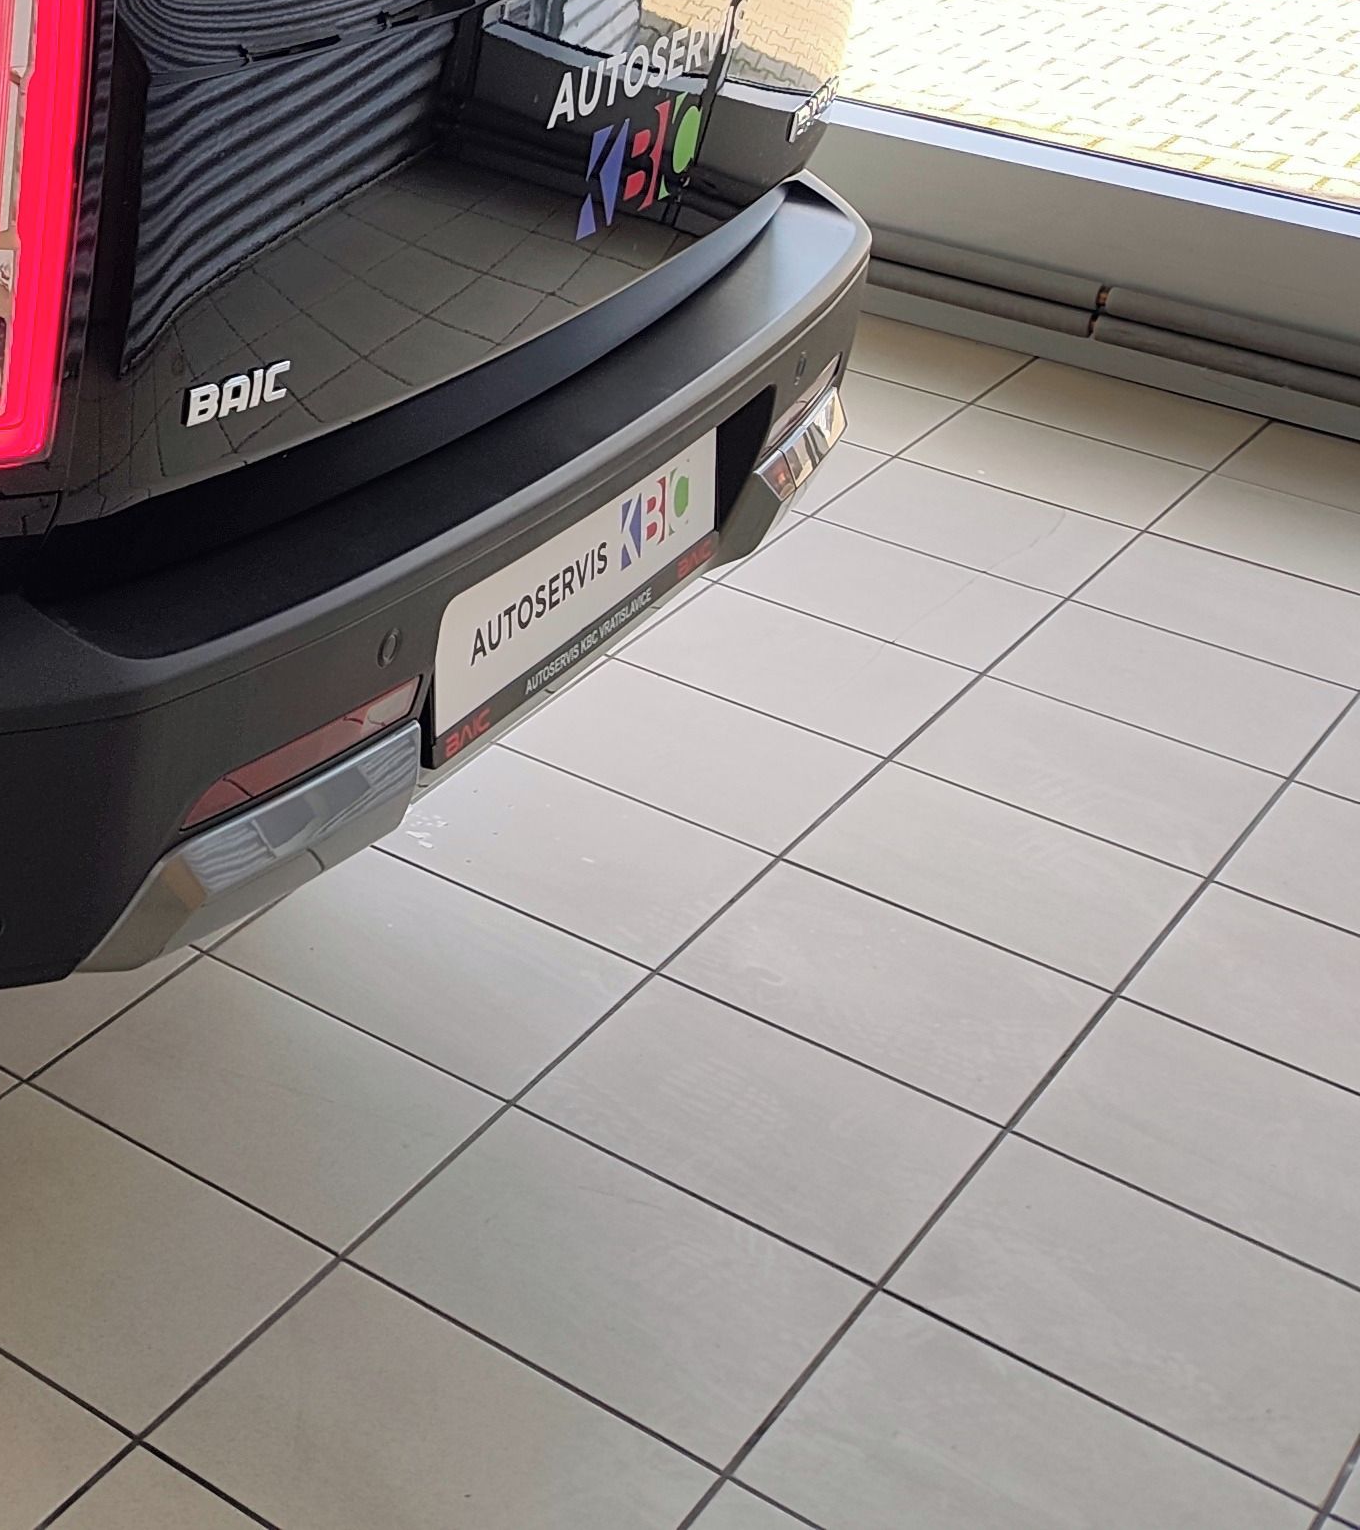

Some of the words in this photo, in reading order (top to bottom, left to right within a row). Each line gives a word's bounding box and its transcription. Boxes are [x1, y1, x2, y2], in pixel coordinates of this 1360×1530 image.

[546, 0, 750, 130] AUTOSERVIS
[183, 359, 291, 428] BAIC
[470, 541, 608, 667] AUTOSERVIS
[524, 640, 580, 695] AUTOSERVIS
[580, 629, 599, 655] KBC
[598, 586, 654, 640] VRATISLAVICE
[445, 709, 492, 758] BAIC
